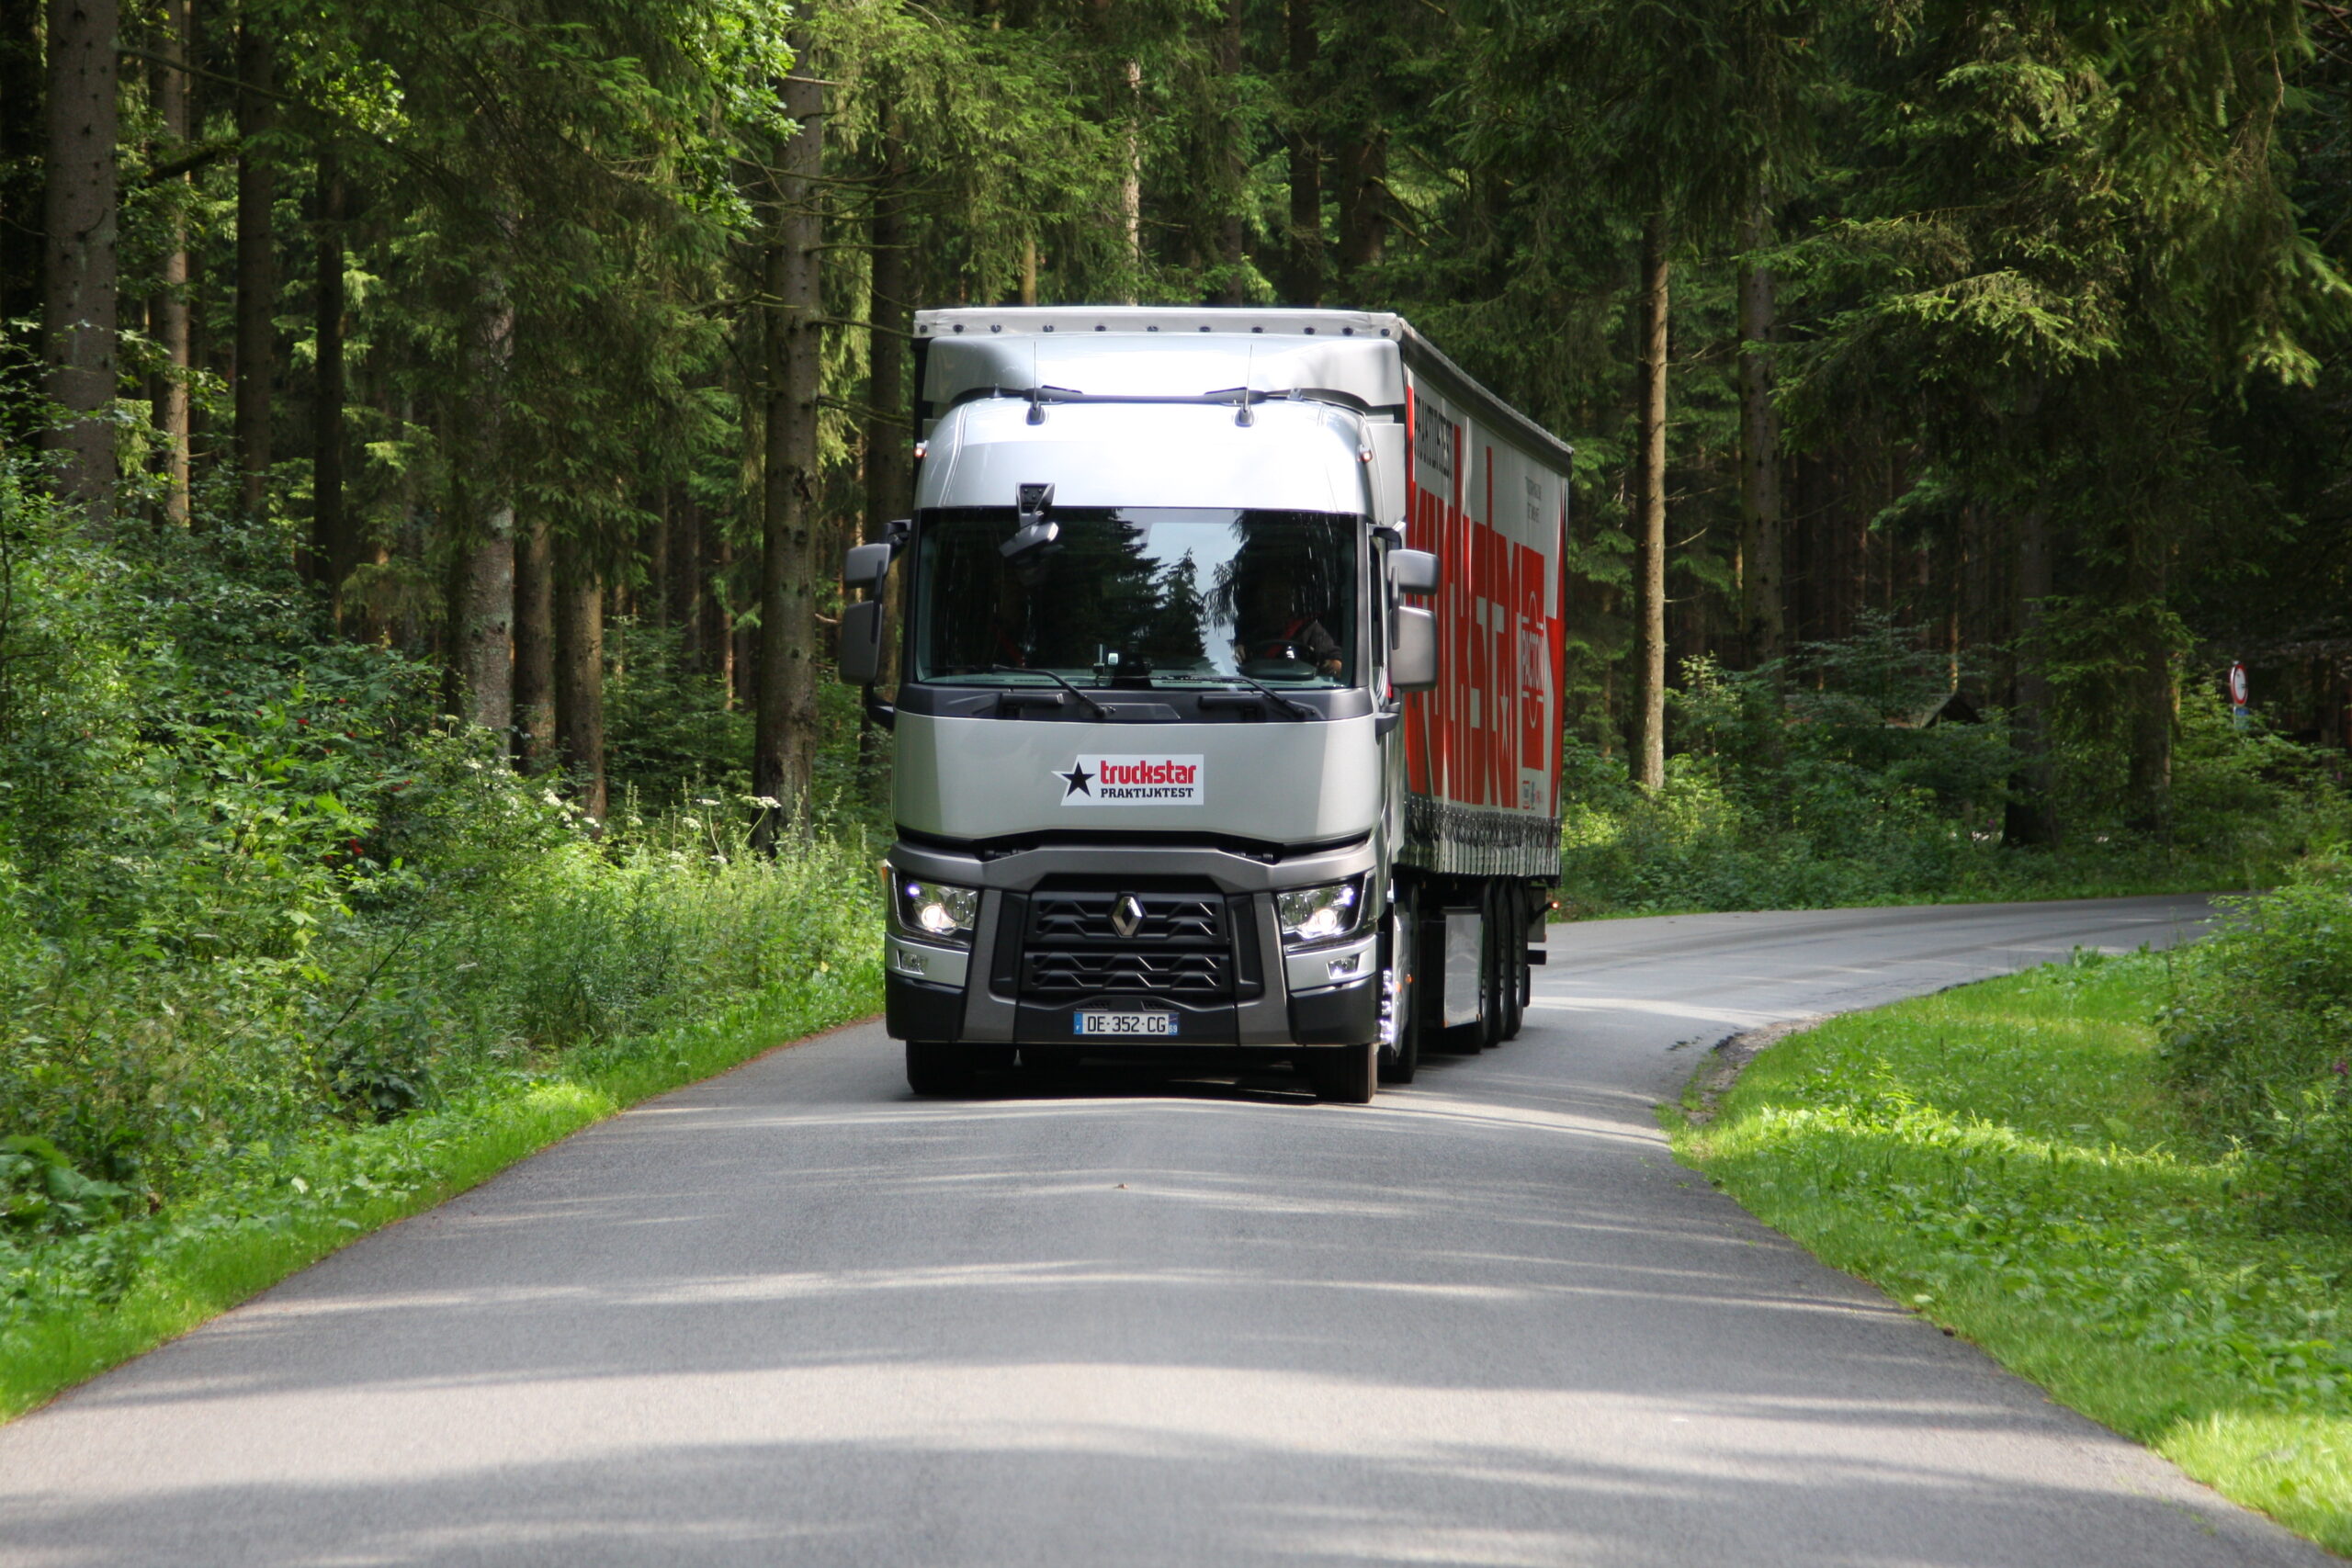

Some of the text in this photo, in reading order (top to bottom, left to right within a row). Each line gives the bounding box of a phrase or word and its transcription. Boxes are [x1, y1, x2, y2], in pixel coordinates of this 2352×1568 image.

[1100, 760, 1197, 784] truckstar
[1100, 787, 1194, 798] PRAKTIJKTEST
[1169, 1025, 1178, 1033] 69
